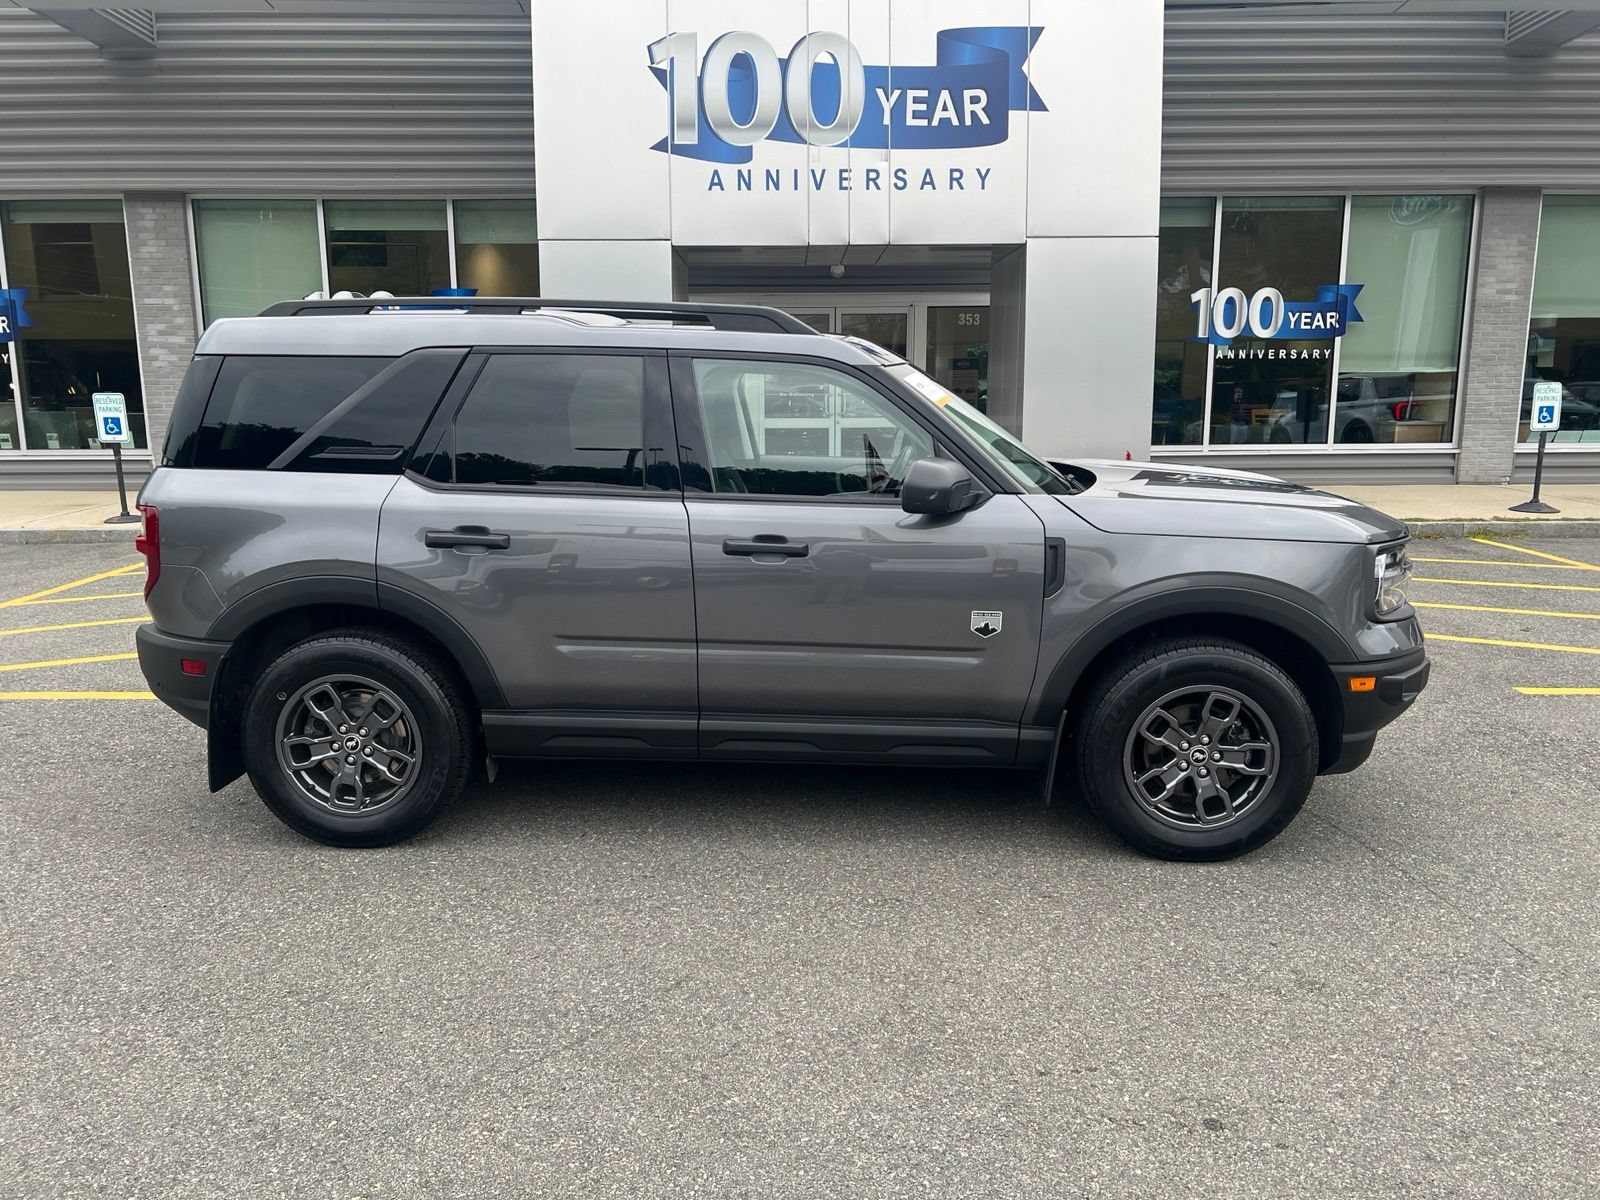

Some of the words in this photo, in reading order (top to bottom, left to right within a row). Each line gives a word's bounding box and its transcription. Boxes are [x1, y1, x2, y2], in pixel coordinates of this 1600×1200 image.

[647, 30, 865, 147] 100
[875, 87, 991, 127] YEAR
[708, 167, 992, 192] ANNIVERSARY
[958, 313, 981, 326] 353
[1190, 286, 1285, 339] 100
[1288, 311, 1340, 330] YEAR
[1215, 348, 1332, 360] ANNIVERSARY
[95, 397, 123, 405] RESERVED
